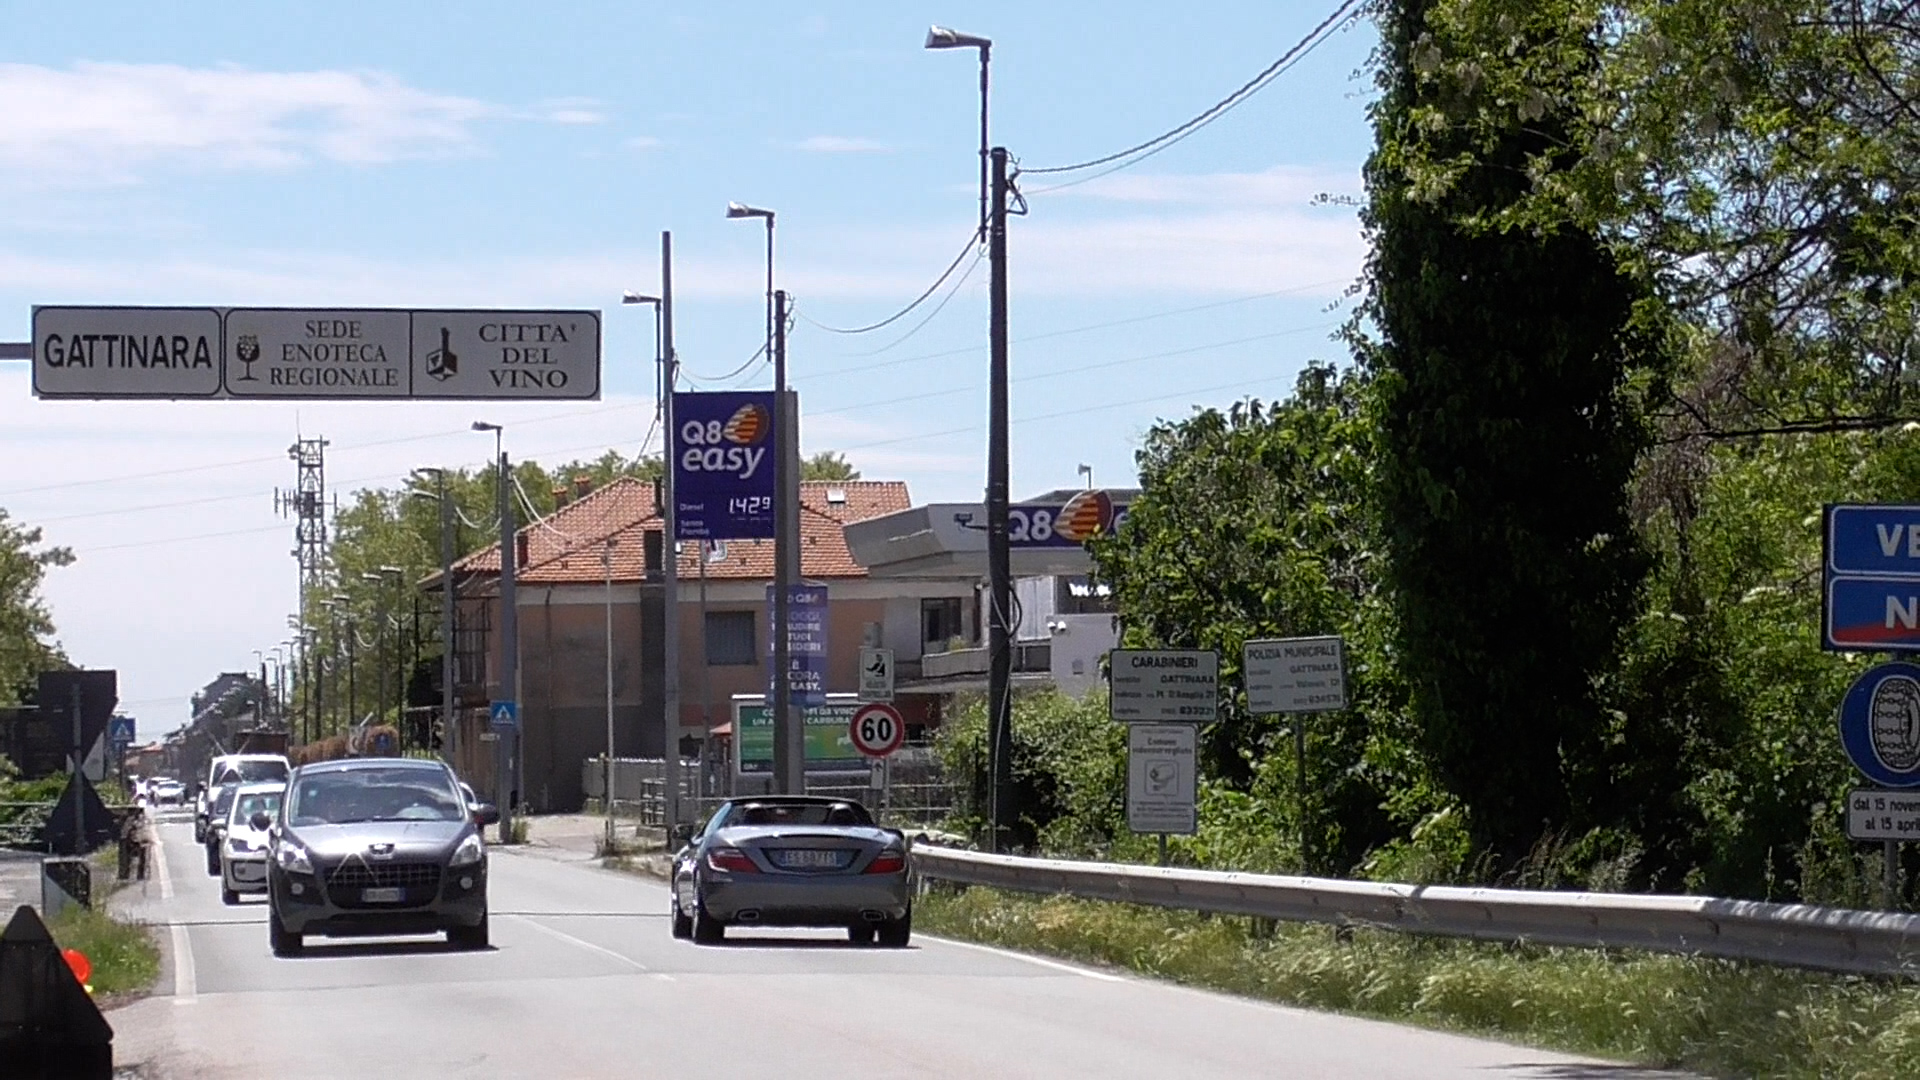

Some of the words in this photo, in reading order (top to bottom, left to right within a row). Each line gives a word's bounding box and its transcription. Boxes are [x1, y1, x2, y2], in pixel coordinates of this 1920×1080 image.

[304, 320, 363, 339] SEDE
[478, 323, 577, 343] CITTA'
[44, 335, 212, 369] GATTINARA
[281, 343, 387, 363] ENOTECA
[502, 346, 558, 365] DEL
[269, 368, 398, 387] REGIONALE
[490, 368, 568, 388] VINO
[681, 420, 722, 445] Q8
[682, 447, 766, 479] easy
[1008, 510, 1053, 541] Q8
[1876, 523, 1920, 558] VE
[1131, 656, 1199, 668] CARABINIERI
[1247, 647, 1281, 660] POLIZIA
[1284, 645, 1337, 658] MUNICIPALE
[1160, 674, 1215, 684] GATTINARA
[862, 718, 892, 741] 60
[1853, 797, 1870, 810] dal
[1874, 797, 1886, 811] 15
[1865, 816, 1876, 830] al
[1880, 816, 1892, 831] 15
